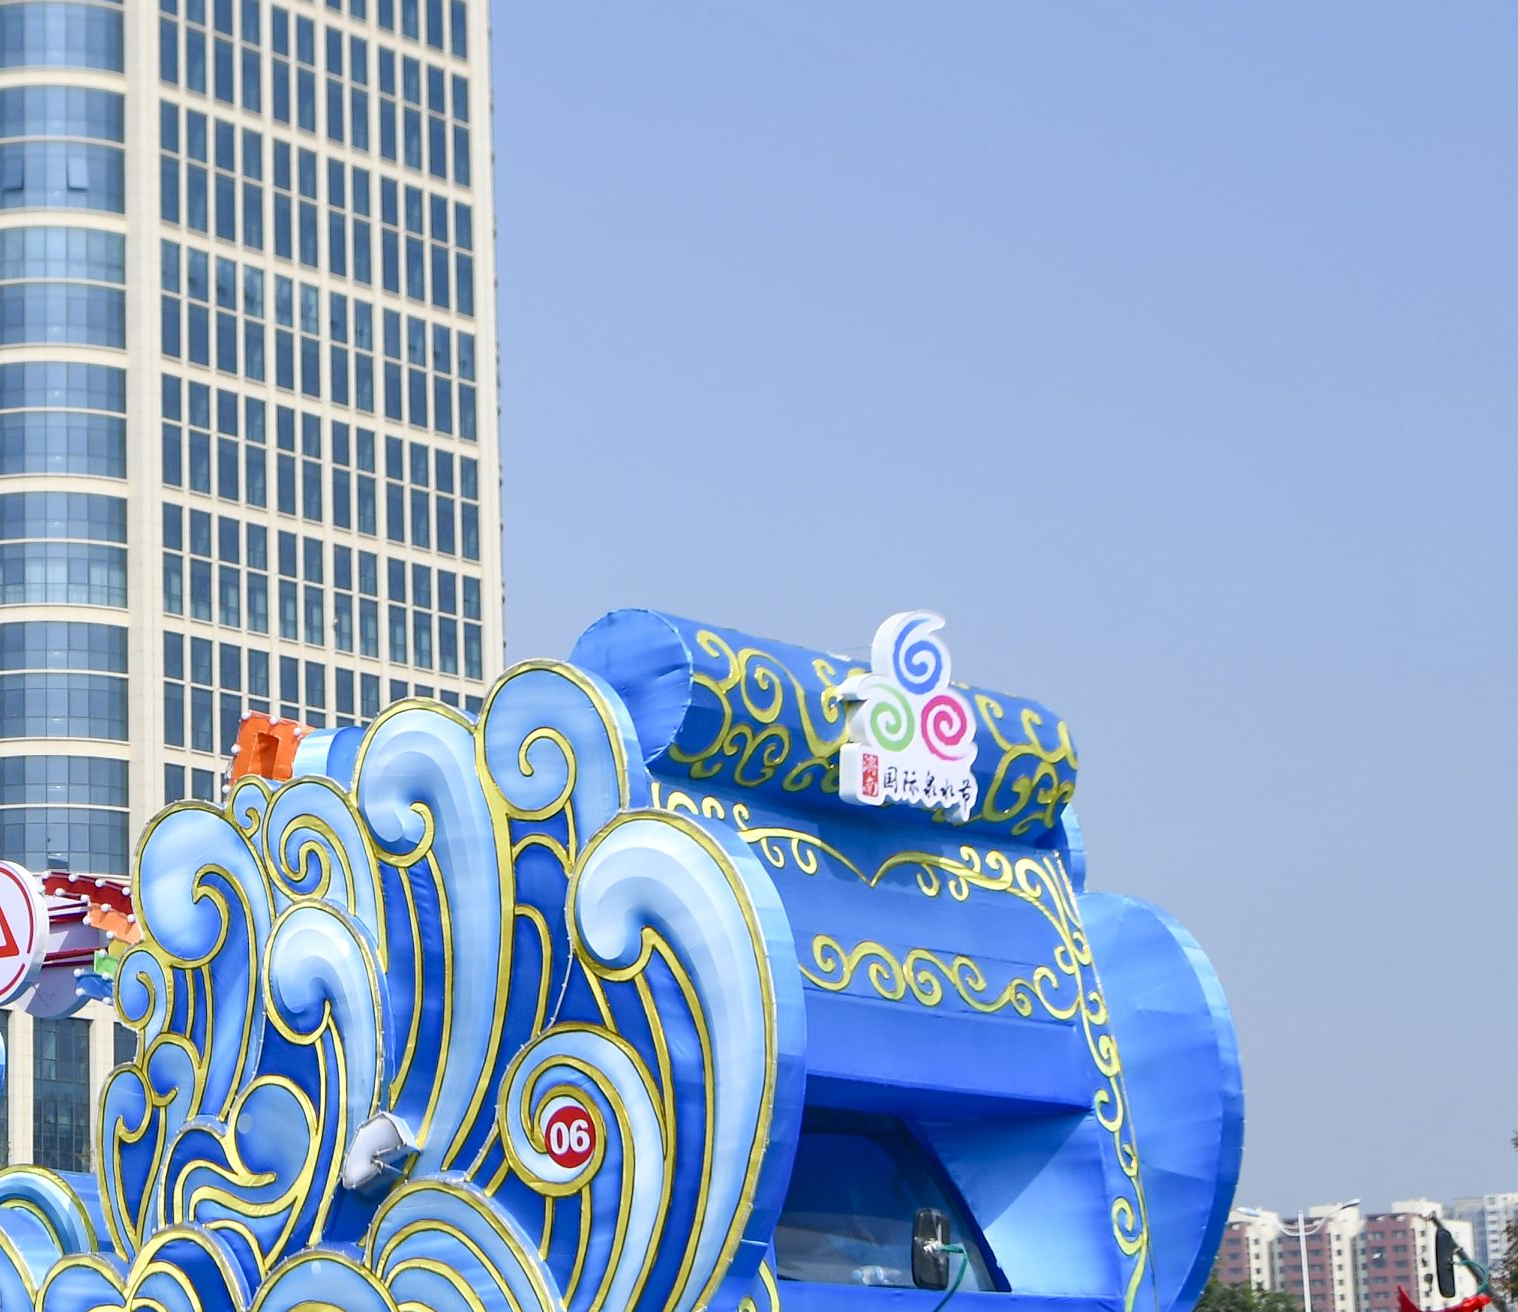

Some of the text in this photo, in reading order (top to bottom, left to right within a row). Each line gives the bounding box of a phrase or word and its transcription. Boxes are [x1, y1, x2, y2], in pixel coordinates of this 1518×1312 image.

[883, 766, 972, 812] 国际泉水节
[549, 1119, 591, 1156] 06
